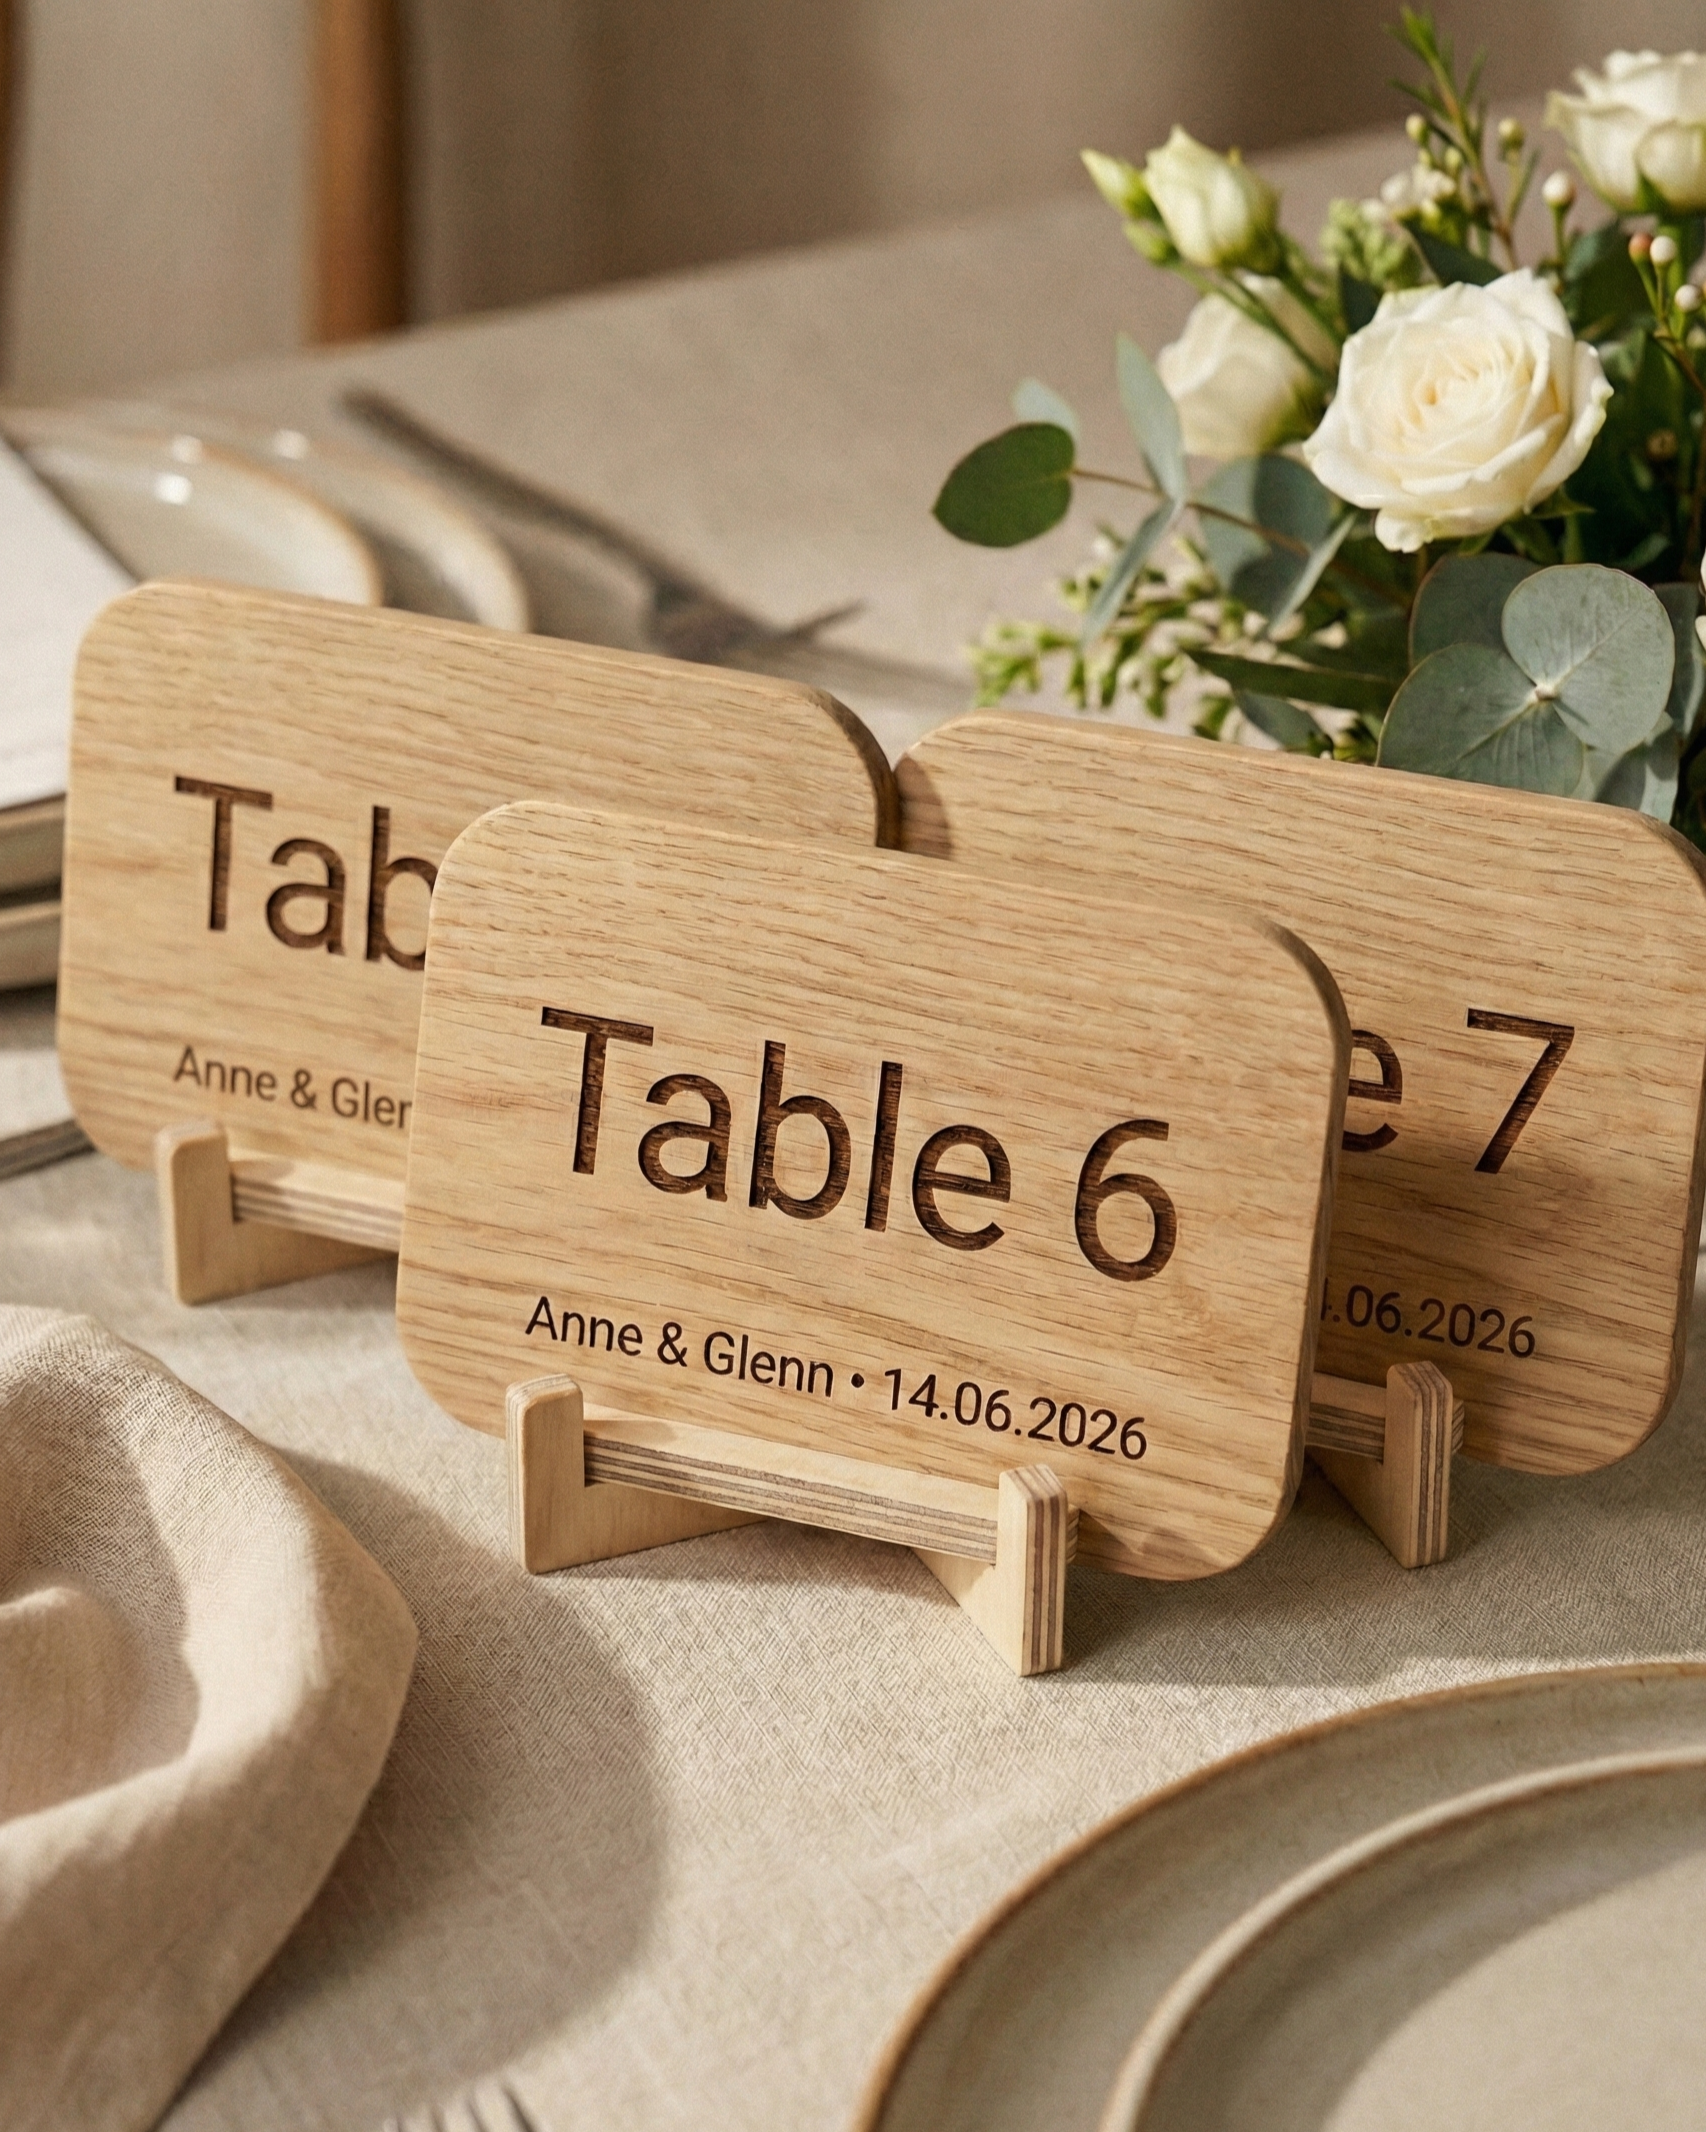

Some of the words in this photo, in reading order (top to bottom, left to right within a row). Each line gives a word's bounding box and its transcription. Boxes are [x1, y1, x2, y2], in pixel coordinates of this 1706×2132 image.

[173, 1044, 278, 1102] Anne
[289, 1067, 318, 1111] &
[541, 1006, 1012, 1251] Table
[1074, 1118, 1178, 1282] 6
[1466, 1007, 1576, 1175] 7
[525, 1295, 643, 1357] Anne
[656, 1320, 689, 1368] &
[703, 1330, 835, 1397] Glenn
[883, 1368, 1148, 1461] 14.06.2026
